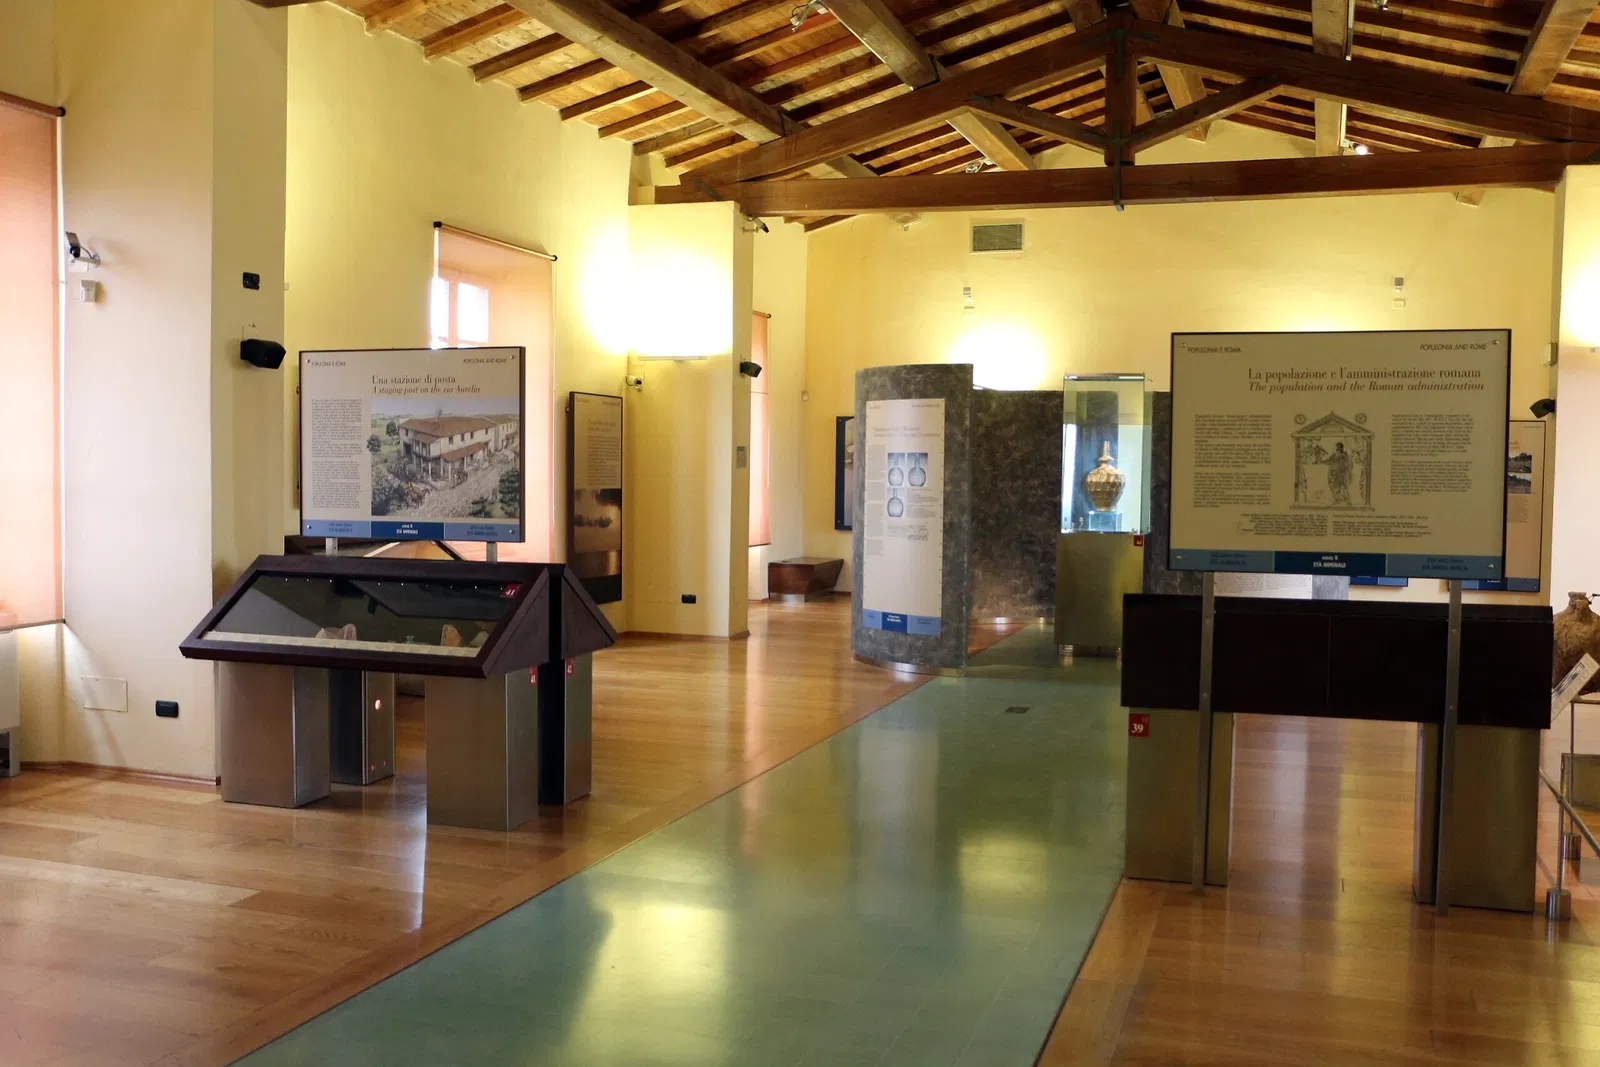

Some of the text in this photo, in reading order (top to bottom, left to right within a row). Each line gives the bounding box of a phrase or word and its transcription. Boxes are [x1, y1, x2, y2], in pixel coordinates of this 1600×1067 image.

[371, 373, 456, 389] Una stazione di posta
[1249, 366, 1481, 383] La popolazione e l'amministrazione romana
[380, 387, 402, 395] staging
[403, 386, 418, 396] post
[431, 385, 441, 393] the
[1249, 380, 1484, 394] The population and the Roman administration
[1131, 722, 1144, 733] 39
